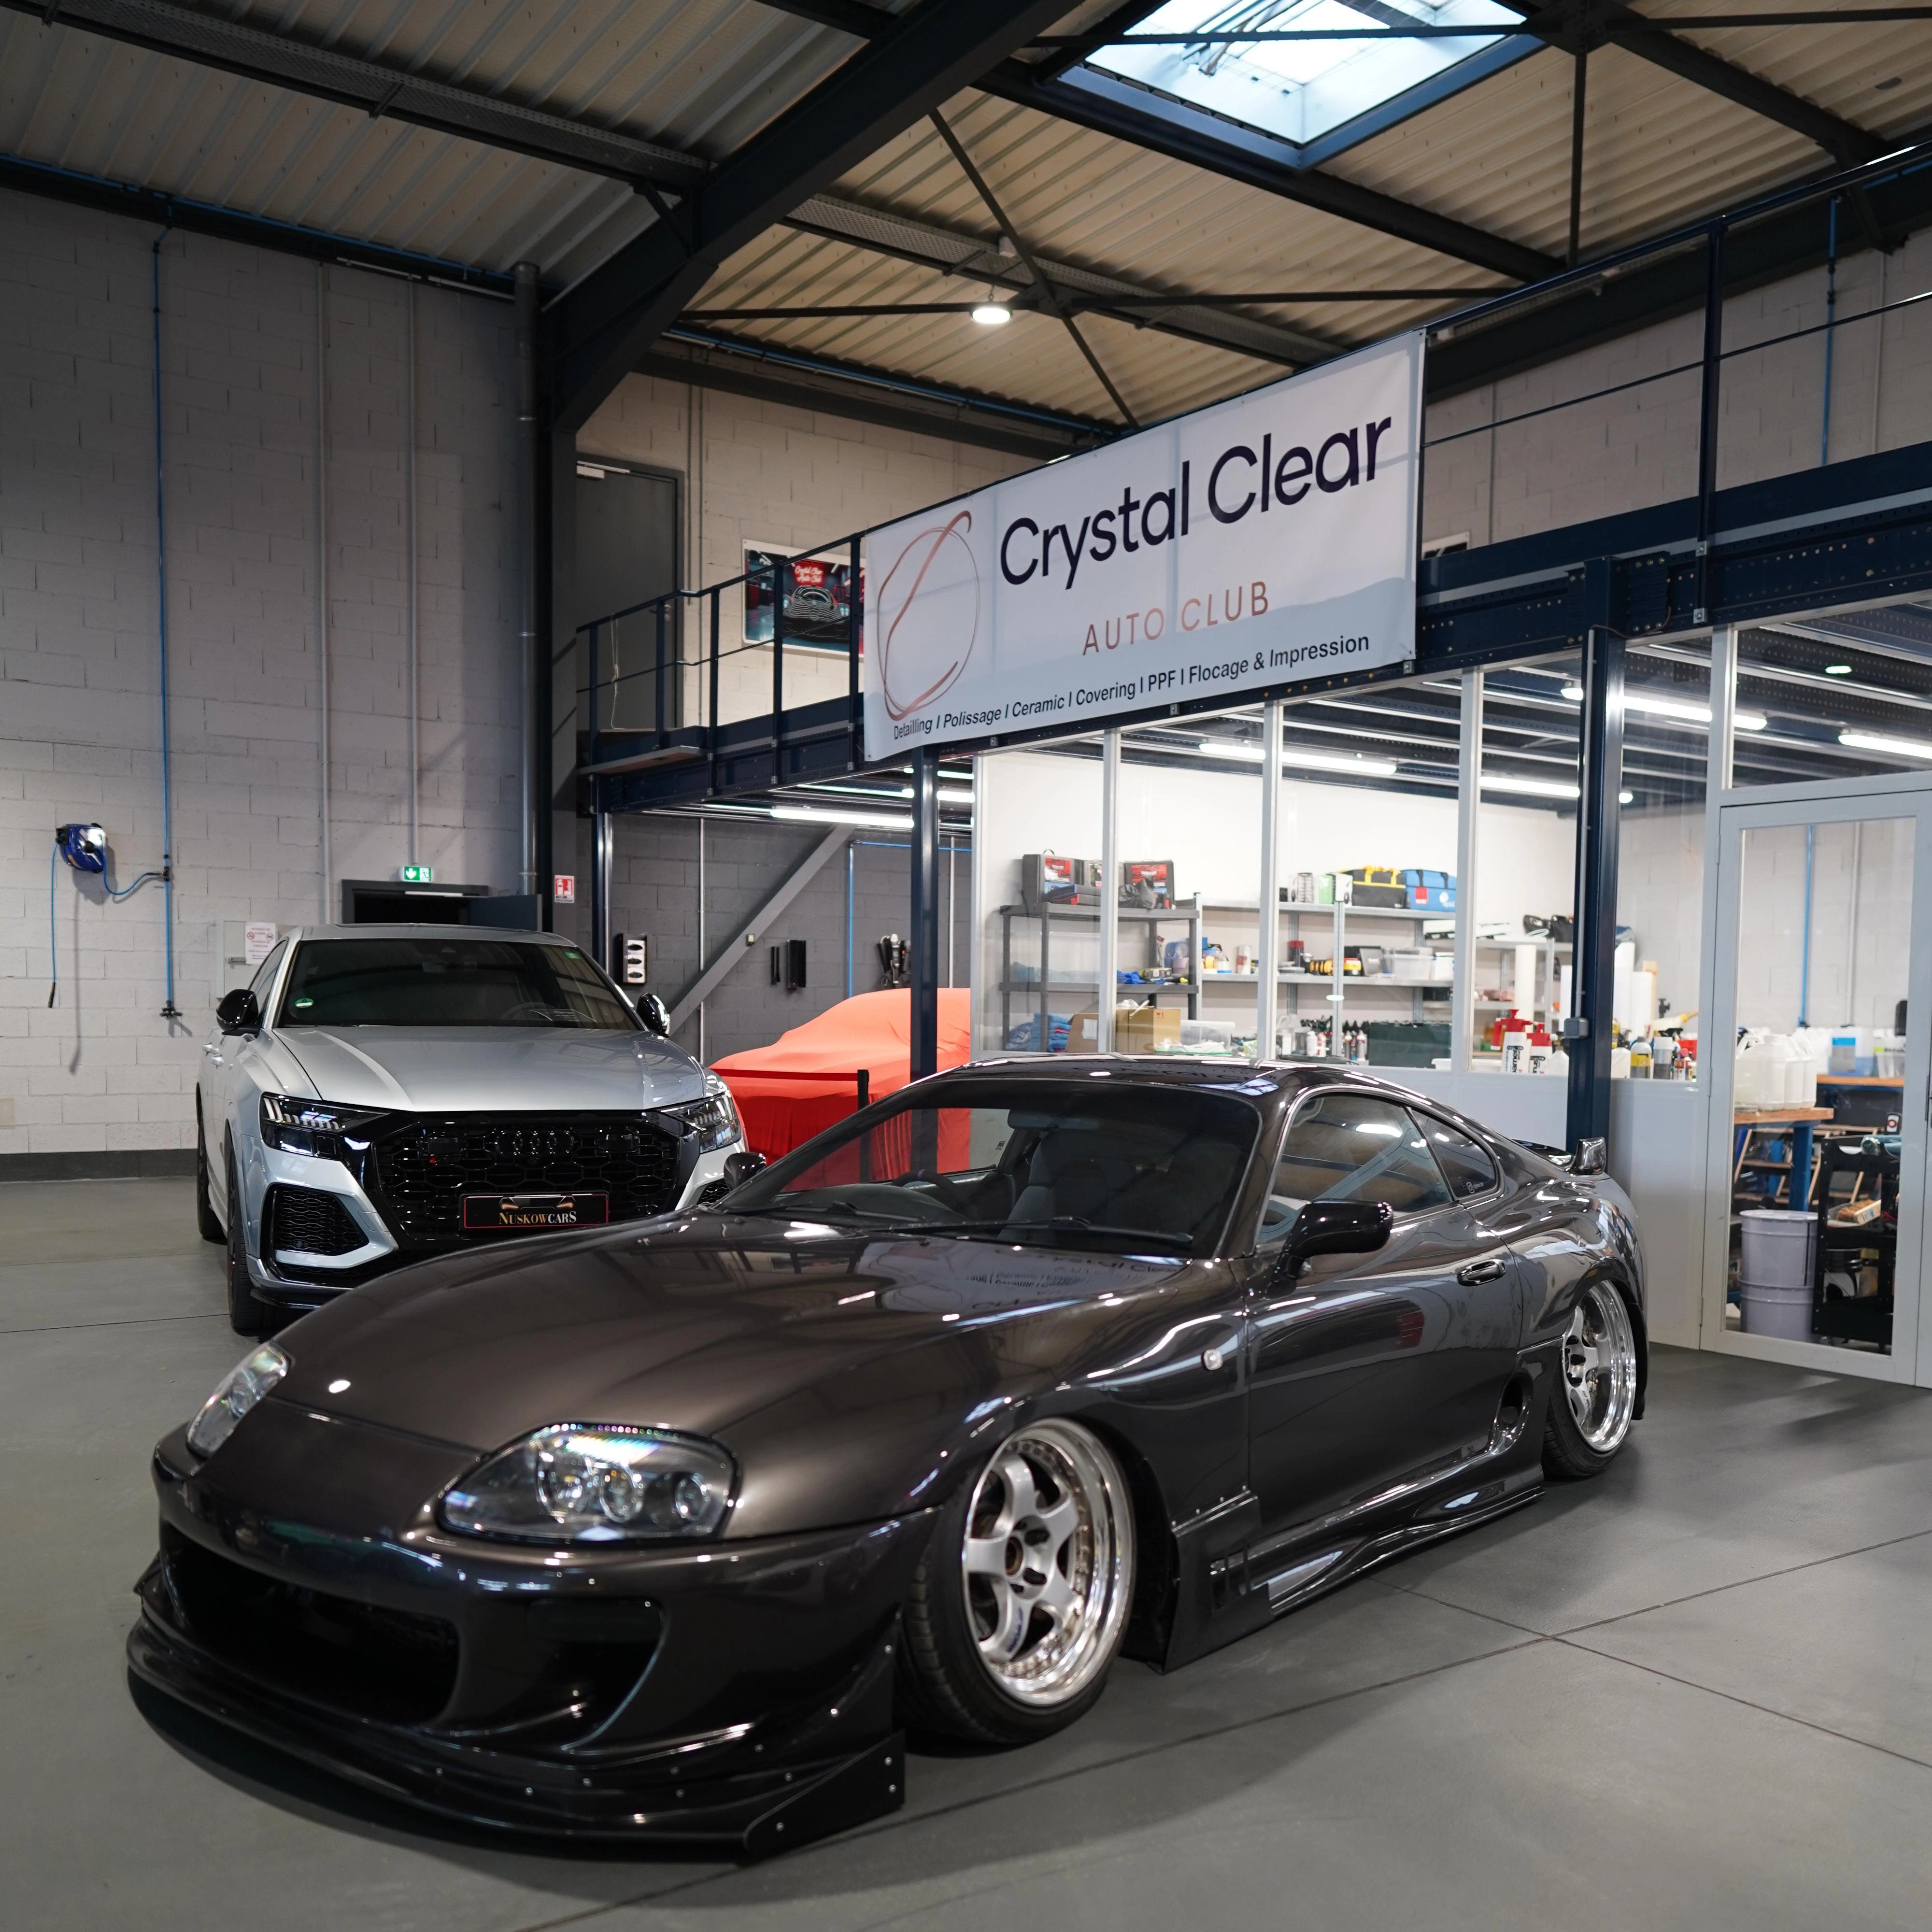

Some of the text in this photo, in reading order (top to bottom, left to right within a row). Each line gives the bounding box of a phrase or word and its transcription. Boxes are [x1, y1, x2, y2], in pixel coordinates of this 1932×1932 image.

[999, 416, 1392, 590] Crystal Clear
[1082, 581, 1270, 656] AUTO CLUB
[894, 717, 934, 740] Detailling
[943, 708, 1002, 728] Polissage
[1012, 696, 1065, 718] Ceramic
[1076, 682, 1136, 706] Covering
[1148, 669, 1176, 692] PPF
[1189, 659, 1249, 684] Flocage
[1253, 652, 1265, 671] &
[1269, 635, 1369, 668] Impression
[498, 1211, 577, 1225] NUSKOWCARS
